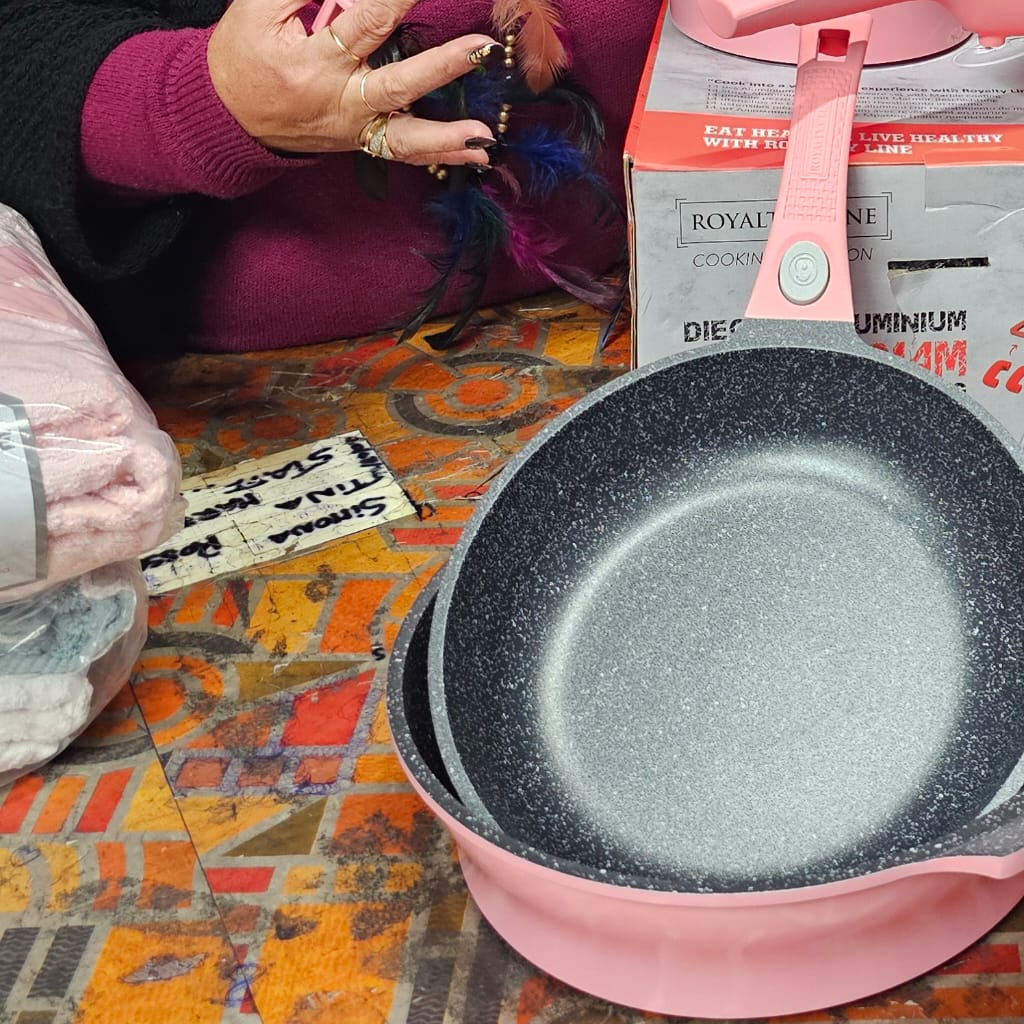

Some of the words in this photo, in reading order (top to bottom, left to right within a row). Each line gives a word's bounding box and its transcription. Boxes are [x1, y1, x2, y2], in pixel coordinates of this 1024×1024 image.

[861, 86, 928, 94] experience
[961, 87, 1007, 95] Royalty
[703, 125, 747, 136] EAT
[859, 132, 905, 143] LIVE
[909, 133, 1004, 144] HEALTHY
[703, 137, 759, 150] WITH
[865, 144, 913, 155] LINE
[692, 250, 764, 268] COOKIN
[853, 310, 968, 334] UMINIUM
